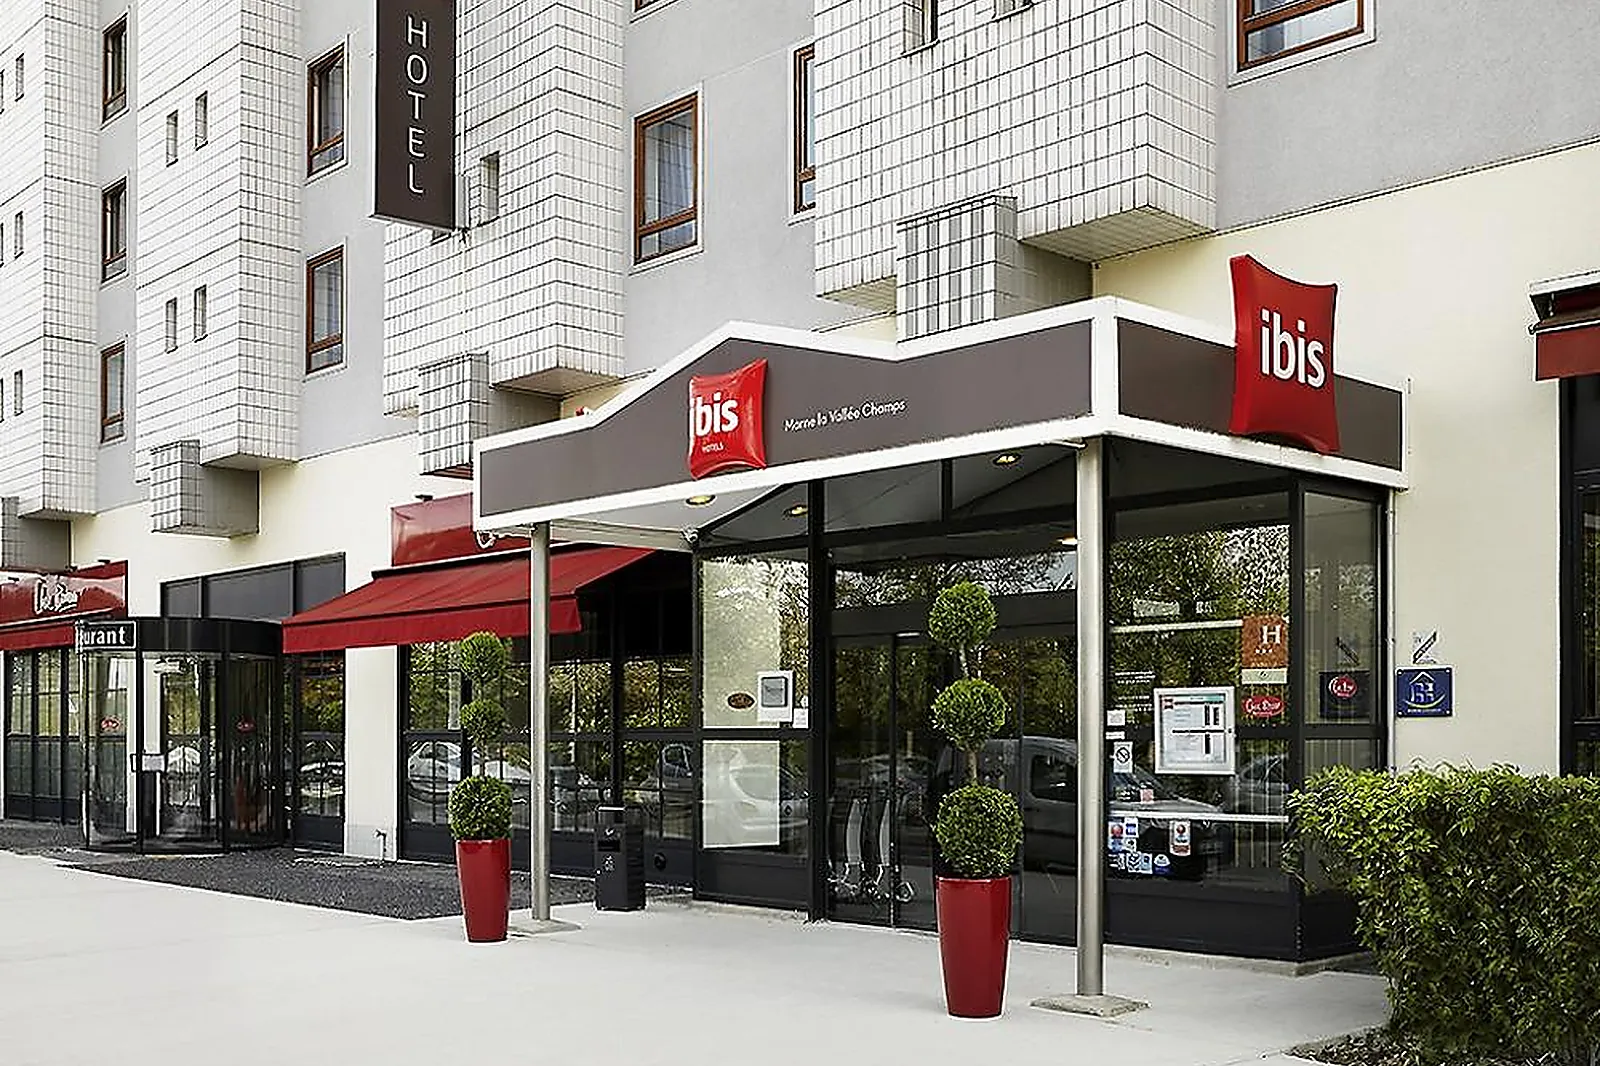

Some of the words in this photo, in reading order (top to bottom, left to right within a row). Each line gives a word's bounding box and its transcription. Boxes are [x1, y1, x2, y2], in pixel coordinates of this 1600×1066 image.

[406, 15, 428, 194] HOTEL
[1261, 308, 1325, 388] ibis
[784, 418, 816, 432] Marne
[817, 412, 827, 426] la
[861, 400, 906, 418] Champs
[1262, 624, 1281, 644] H
